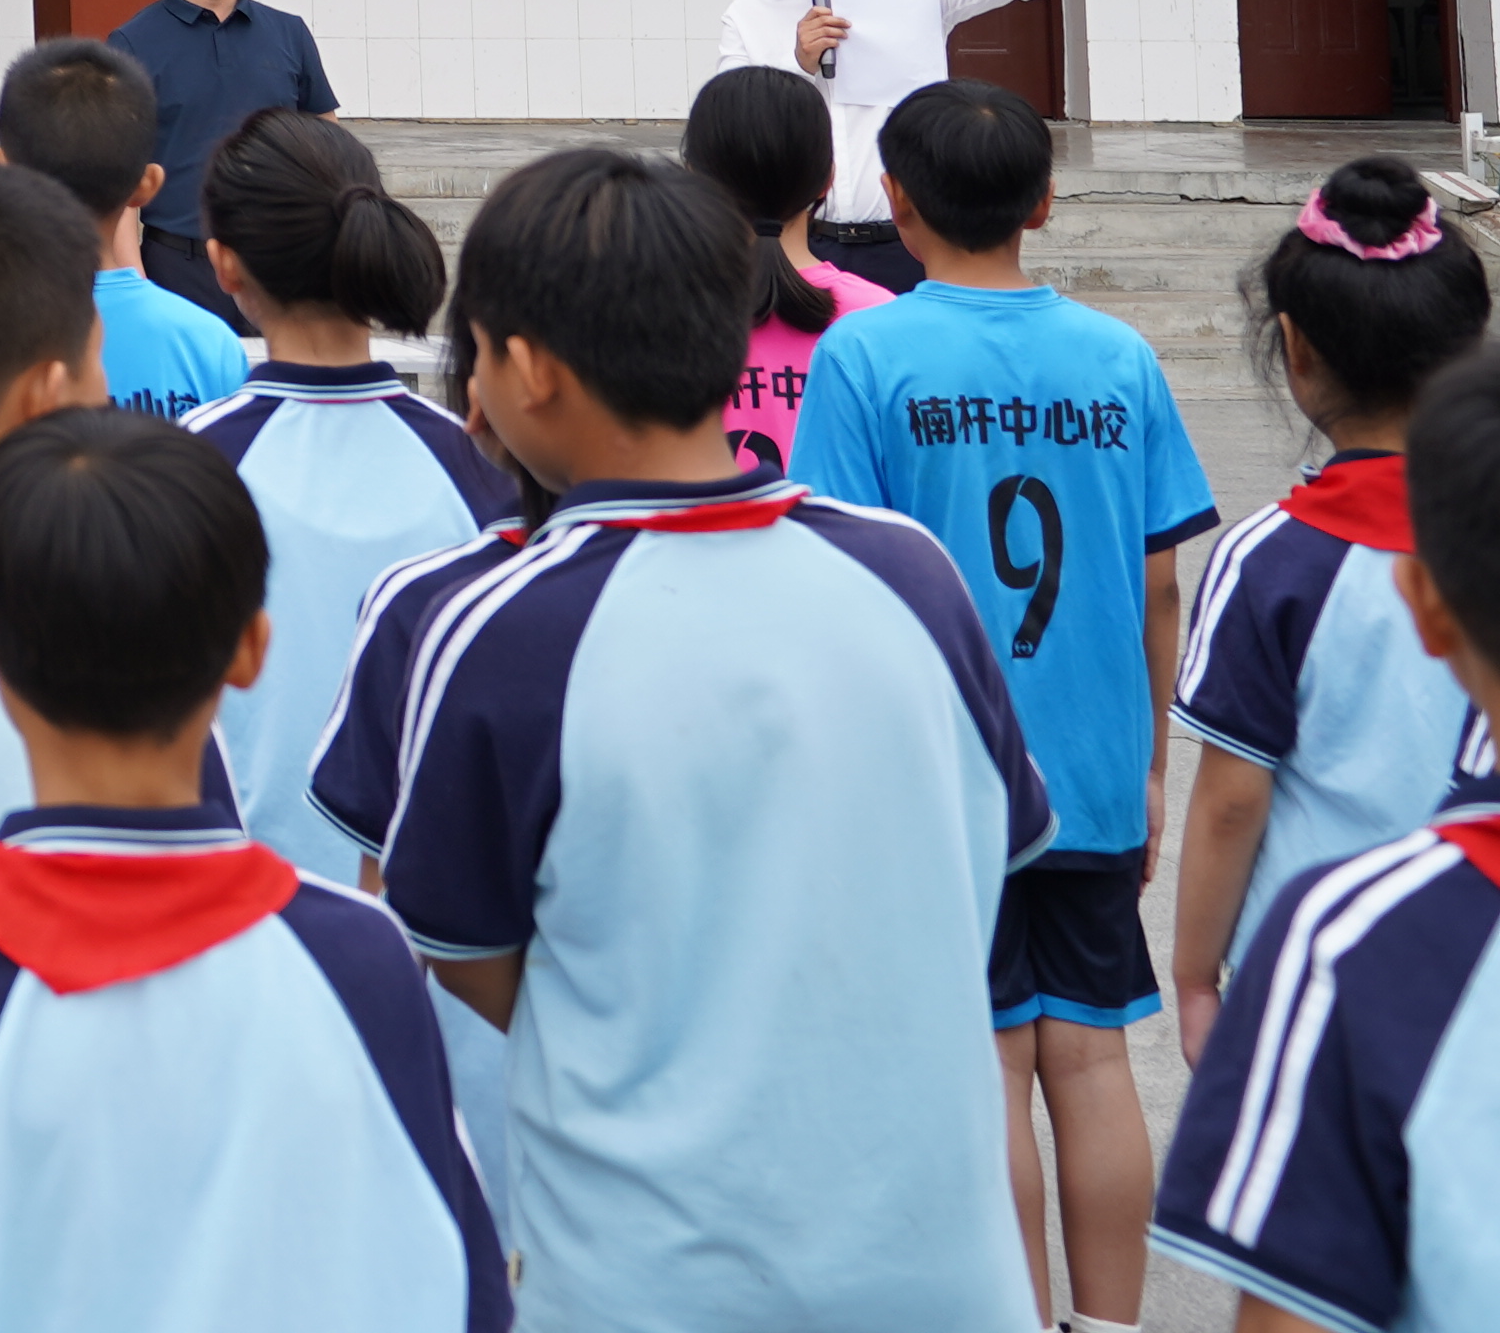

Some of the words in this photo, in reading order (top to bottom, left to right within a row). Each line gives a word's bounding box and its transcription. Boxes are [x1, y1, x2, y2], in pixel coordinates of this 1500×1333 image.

[905, 394, 1128, 451] 楠杆中心校
[988, 474, 1063, 658] 9
